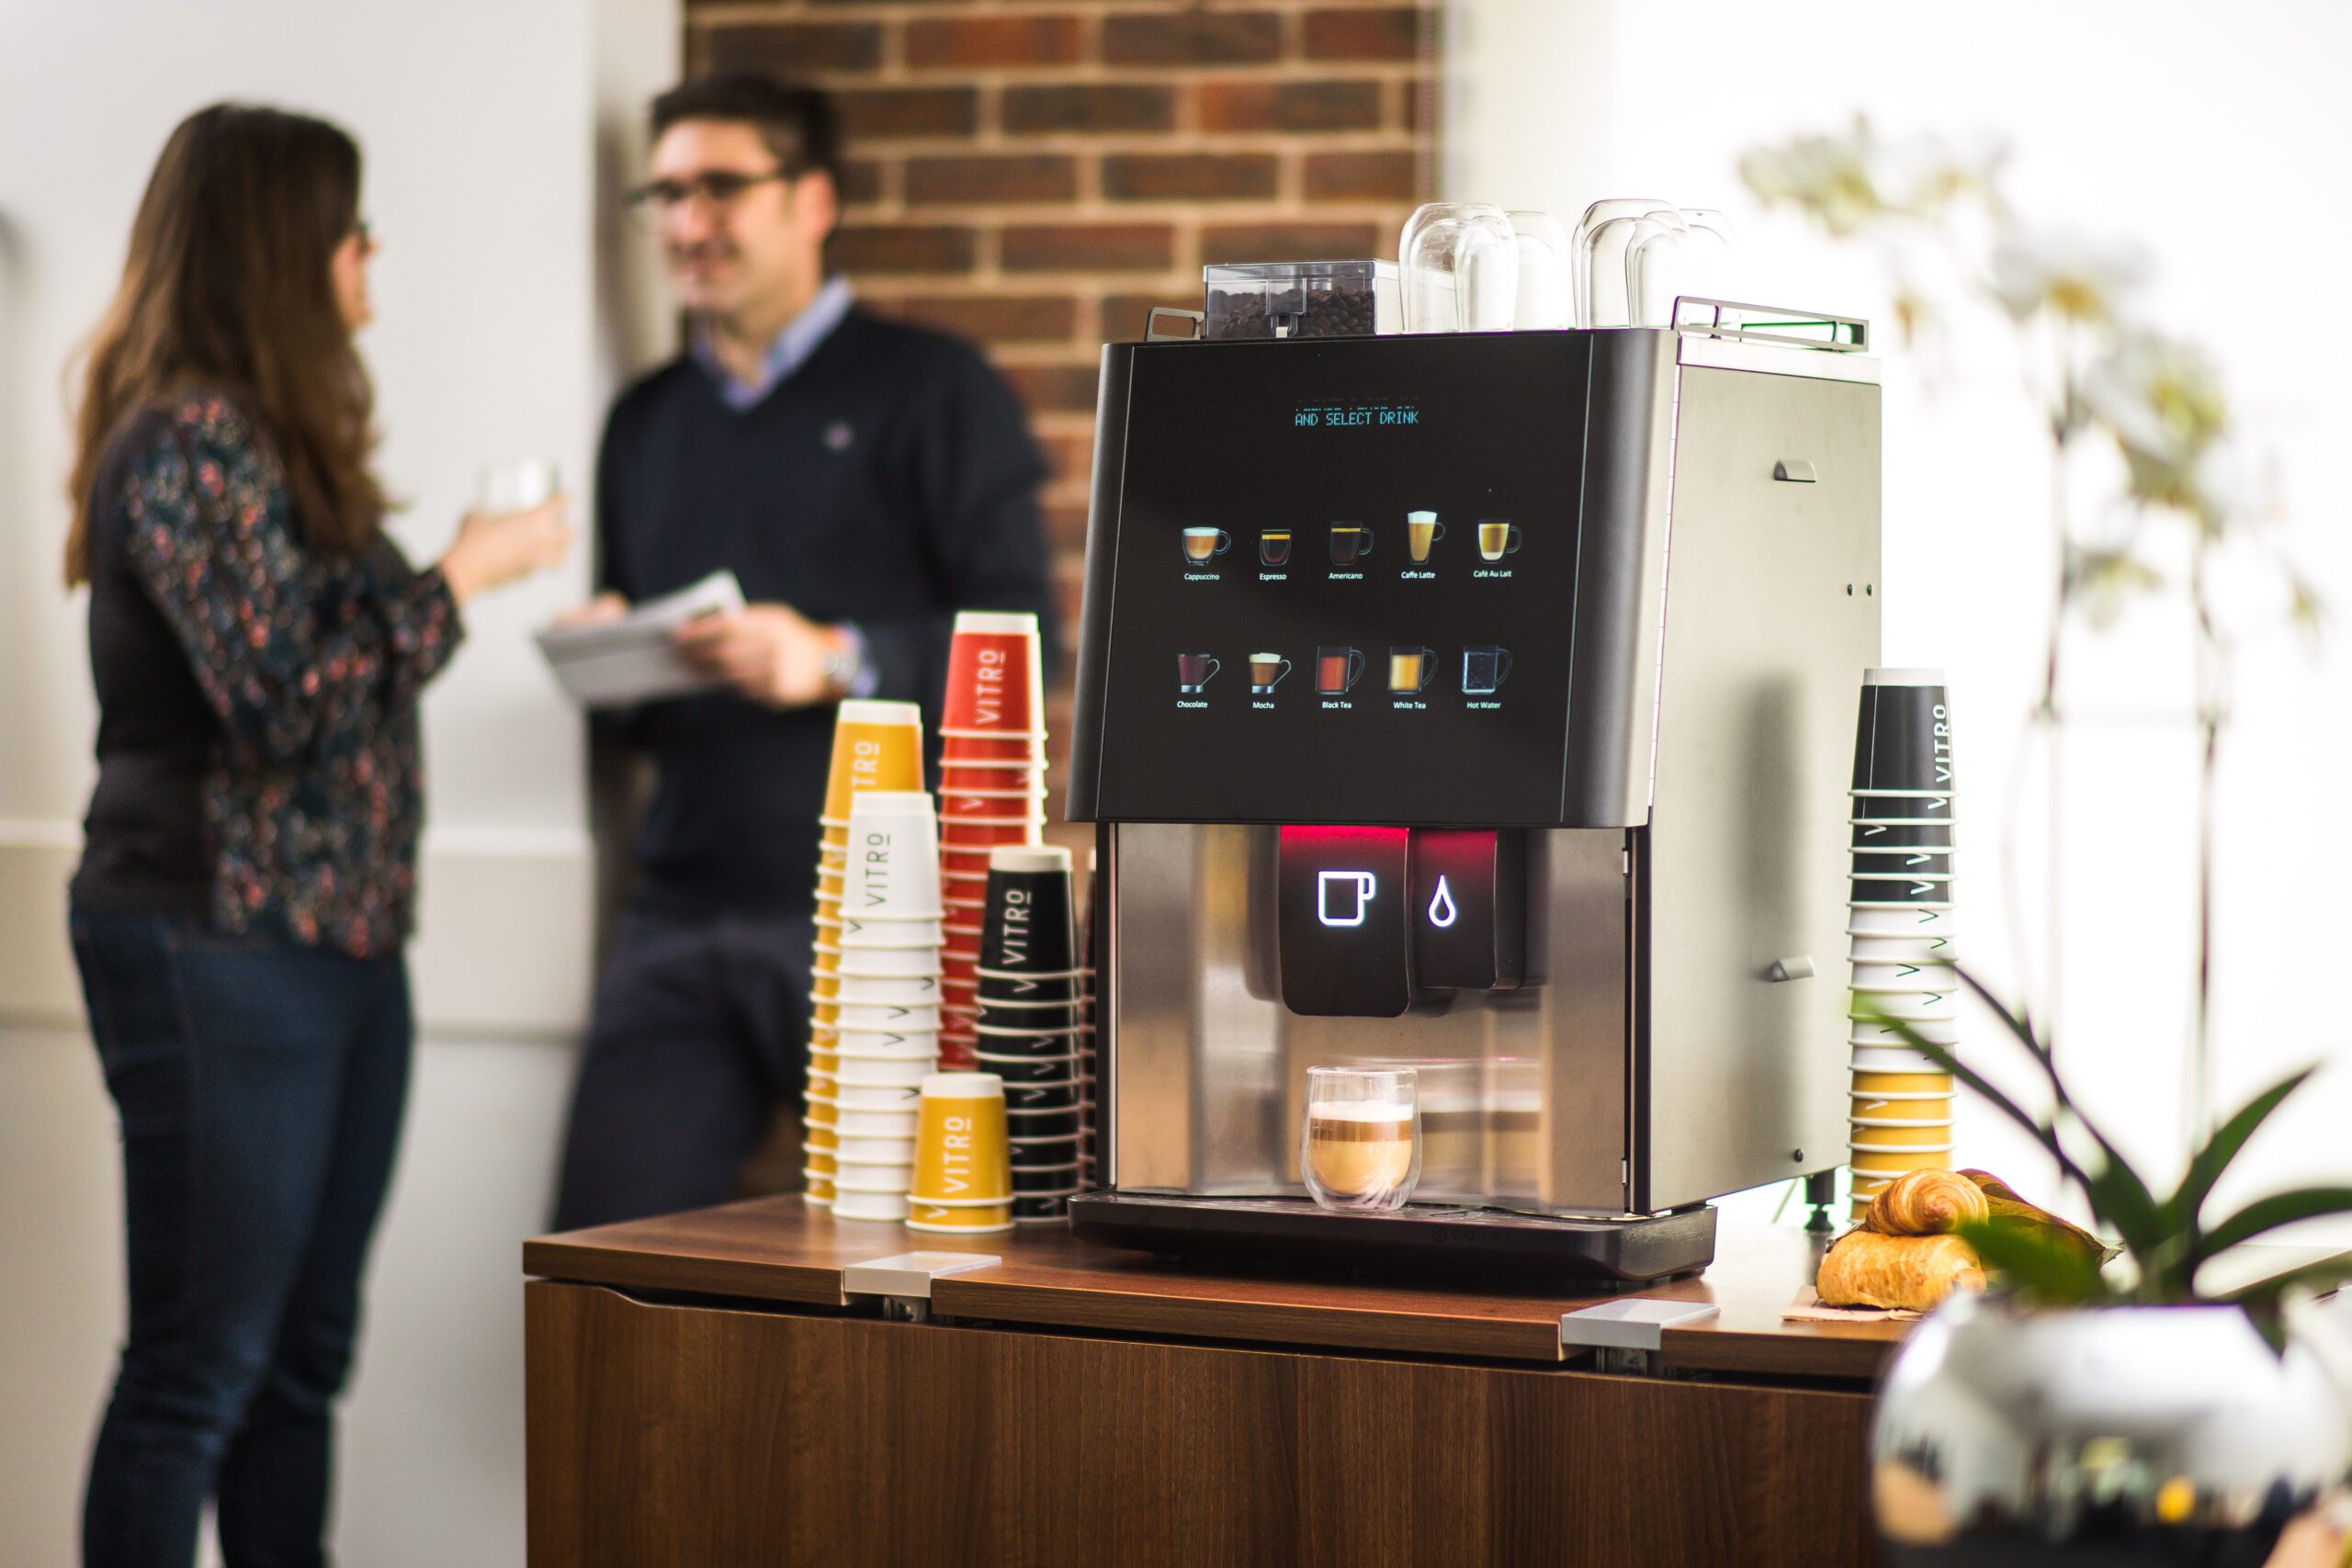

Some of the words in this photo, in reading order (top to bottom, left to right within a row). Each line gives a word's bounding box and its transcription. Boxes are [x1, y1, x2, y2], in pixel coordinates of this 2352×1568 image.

[1295, 413, 1318, 426] AND
[1326, 412, 1373, 425] SELECT
[1379, 411, 1419, 424] DRINK
[1183, 572, 1220, 581] Cappuccino
[1259, 572, 1287, 581] Espresso
[1473, 570, 1488, 578] Café
[1322, 701, 1339, 709] Black
[1340, 701, 1352, 709] Tea
[1393, 701, 1413, 709] White
[1414, 701, 1427, 709] Tea
[1480, 701, 1501, 709] Water
[1933, 704, 1952, 783] VITRO
[852, 740, 881, 788] TRO
